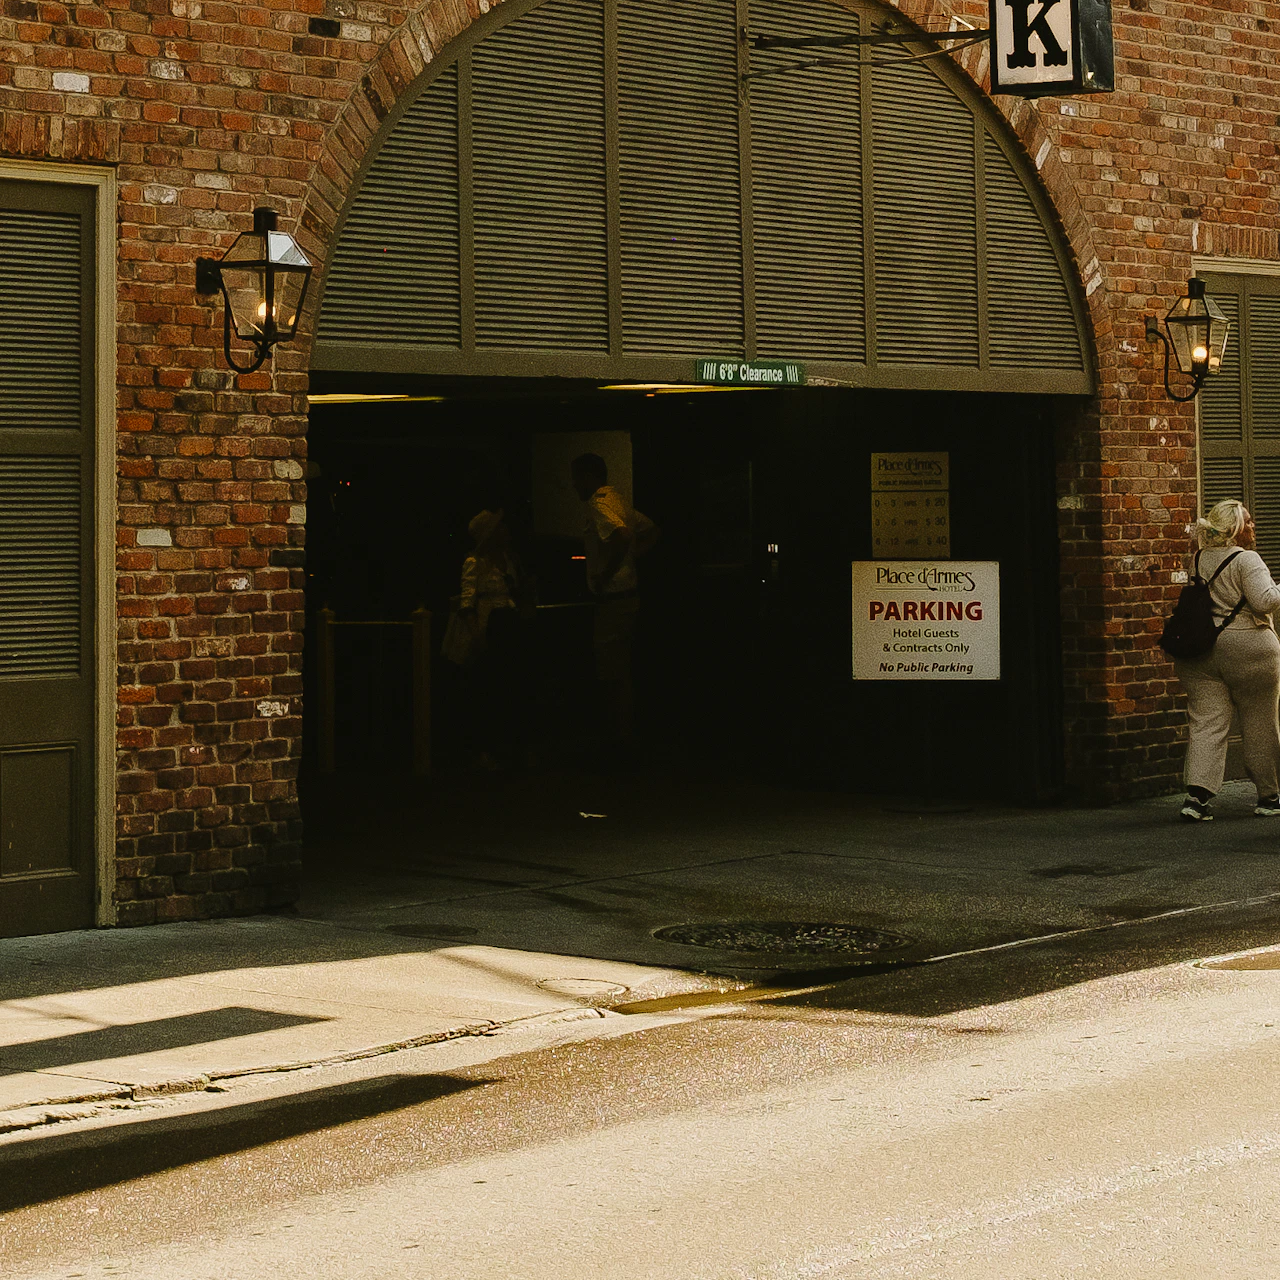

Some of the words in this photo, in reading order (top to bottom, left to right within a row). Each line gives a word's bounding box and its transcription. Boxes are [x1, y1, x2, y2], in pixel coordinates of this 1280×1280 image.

[740, 363, 783, 382] Clearance
[877, 458, 903, 471] Place
[934, 498, 946, 507] 20
[934, 516, 946, 526] 30
[936, 536, 947, 545] 40
[876, 567, 915, 584] Place
[869, 601, 983, 621] PARKING
[893, 628, 921, 638] Hotel
[924, 628, 959, 638] Guests
[882, 643, 890, 652] &
[893, 643, 943, 653] Contracts
[945, 643, 970, 655] Only
[879, 663, 894, 672] No
[896, 662, 929, 672] Public
[931, 662, 974, 674] Parking
